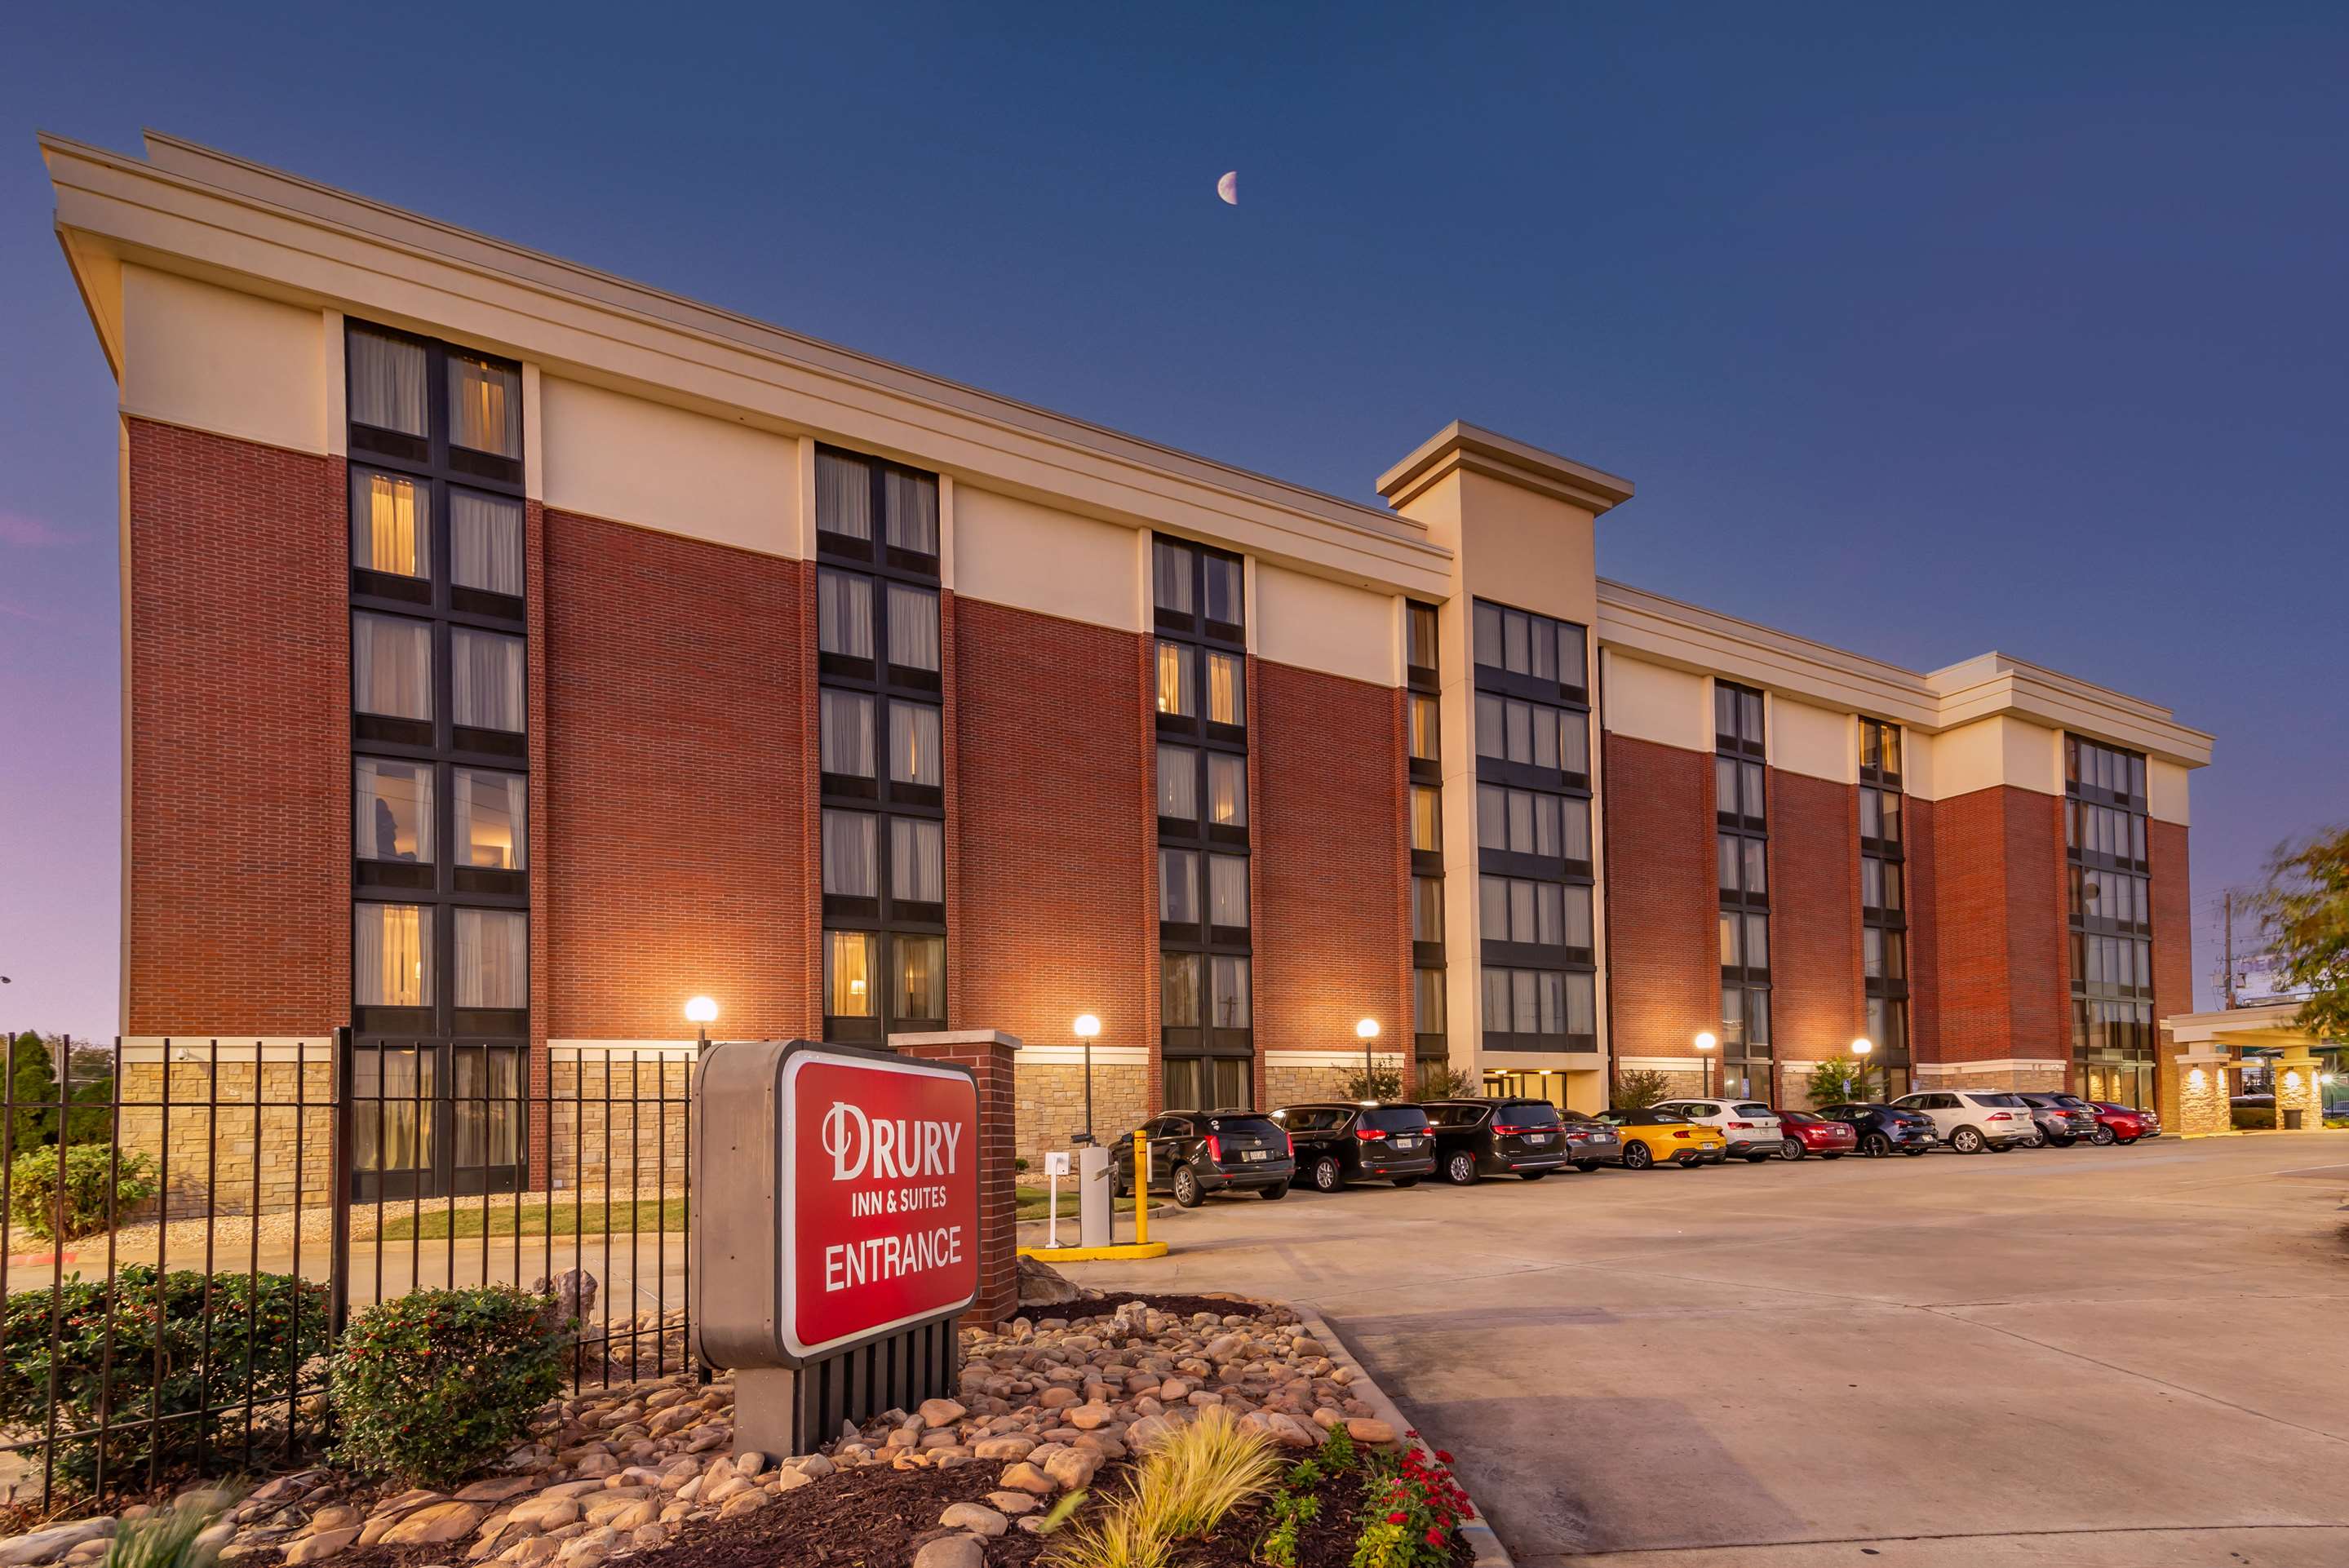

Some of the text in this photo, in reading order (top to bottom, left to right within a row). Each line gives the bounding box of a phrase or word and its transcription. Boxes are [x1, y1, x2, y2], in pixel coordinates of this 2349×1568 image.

[822, 1101, 962, 1180] DRURY
[852, 1185, 946, 1217] INN & SUITES
[826, 1225, 962, 1292] ENTRANCE
